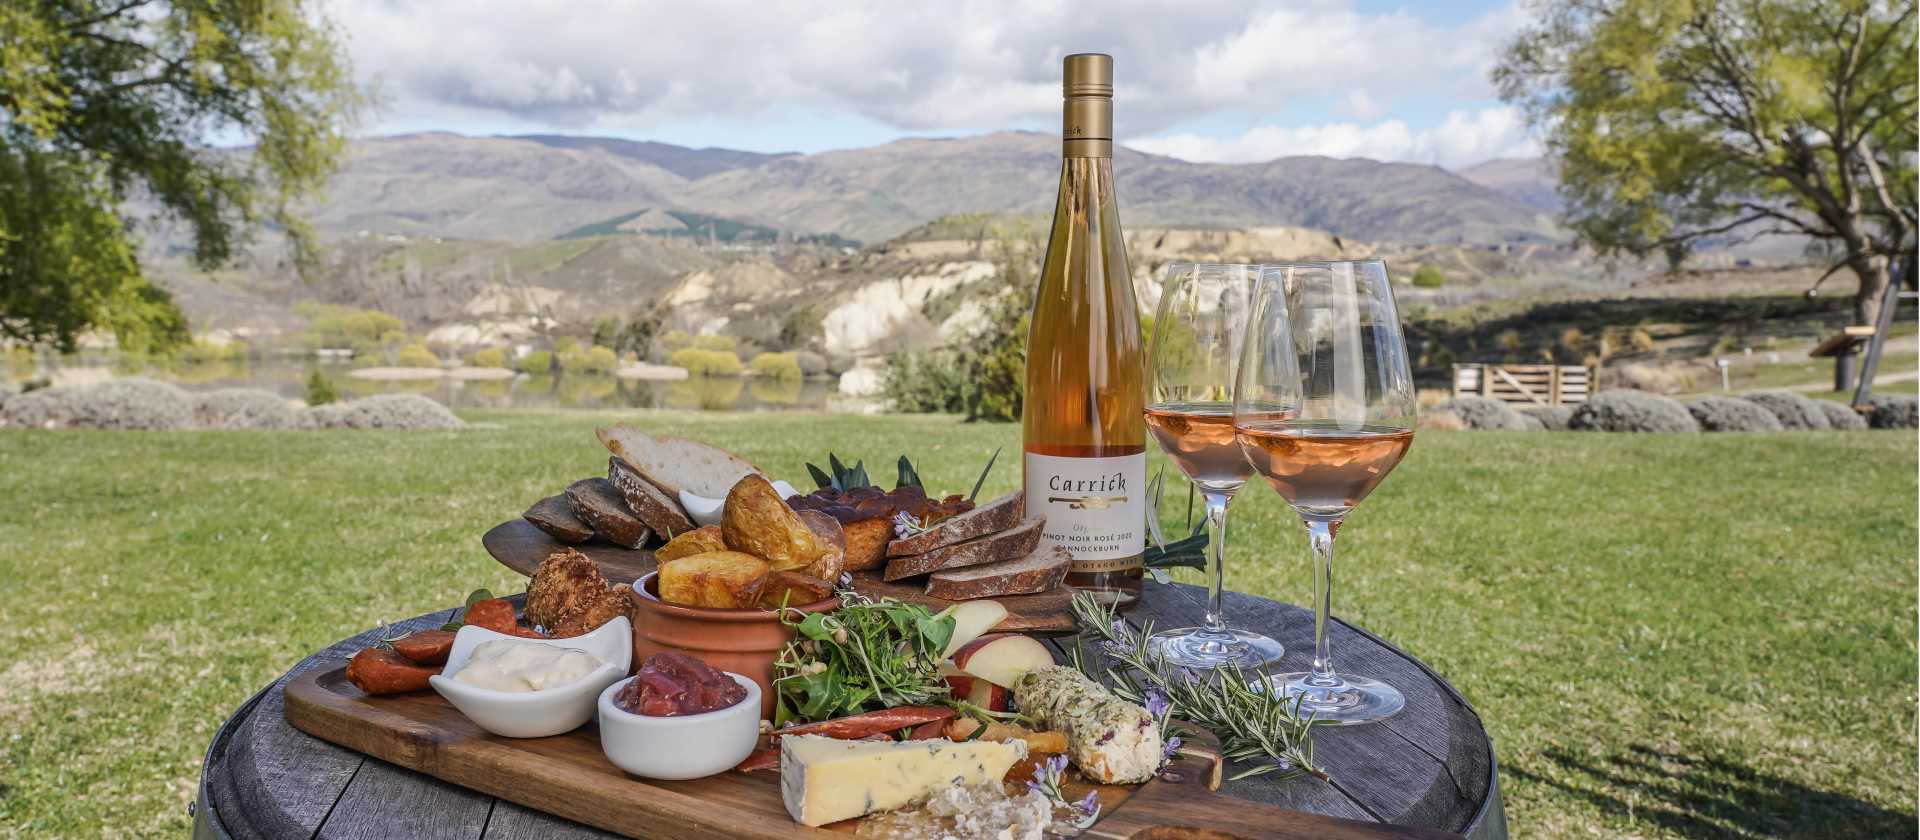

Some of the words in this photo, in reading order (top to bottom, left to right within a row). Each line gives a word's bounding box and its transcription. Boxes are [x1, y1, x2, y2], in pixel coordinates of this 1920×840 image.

[1049, 472, 1126, 492] Carrick
[1042, 533, 1065, 541] PINOT
[1094, 533, 1114, 541] ROSÉ
[1063, 544, 1120, 552] ANNOCKBURN
